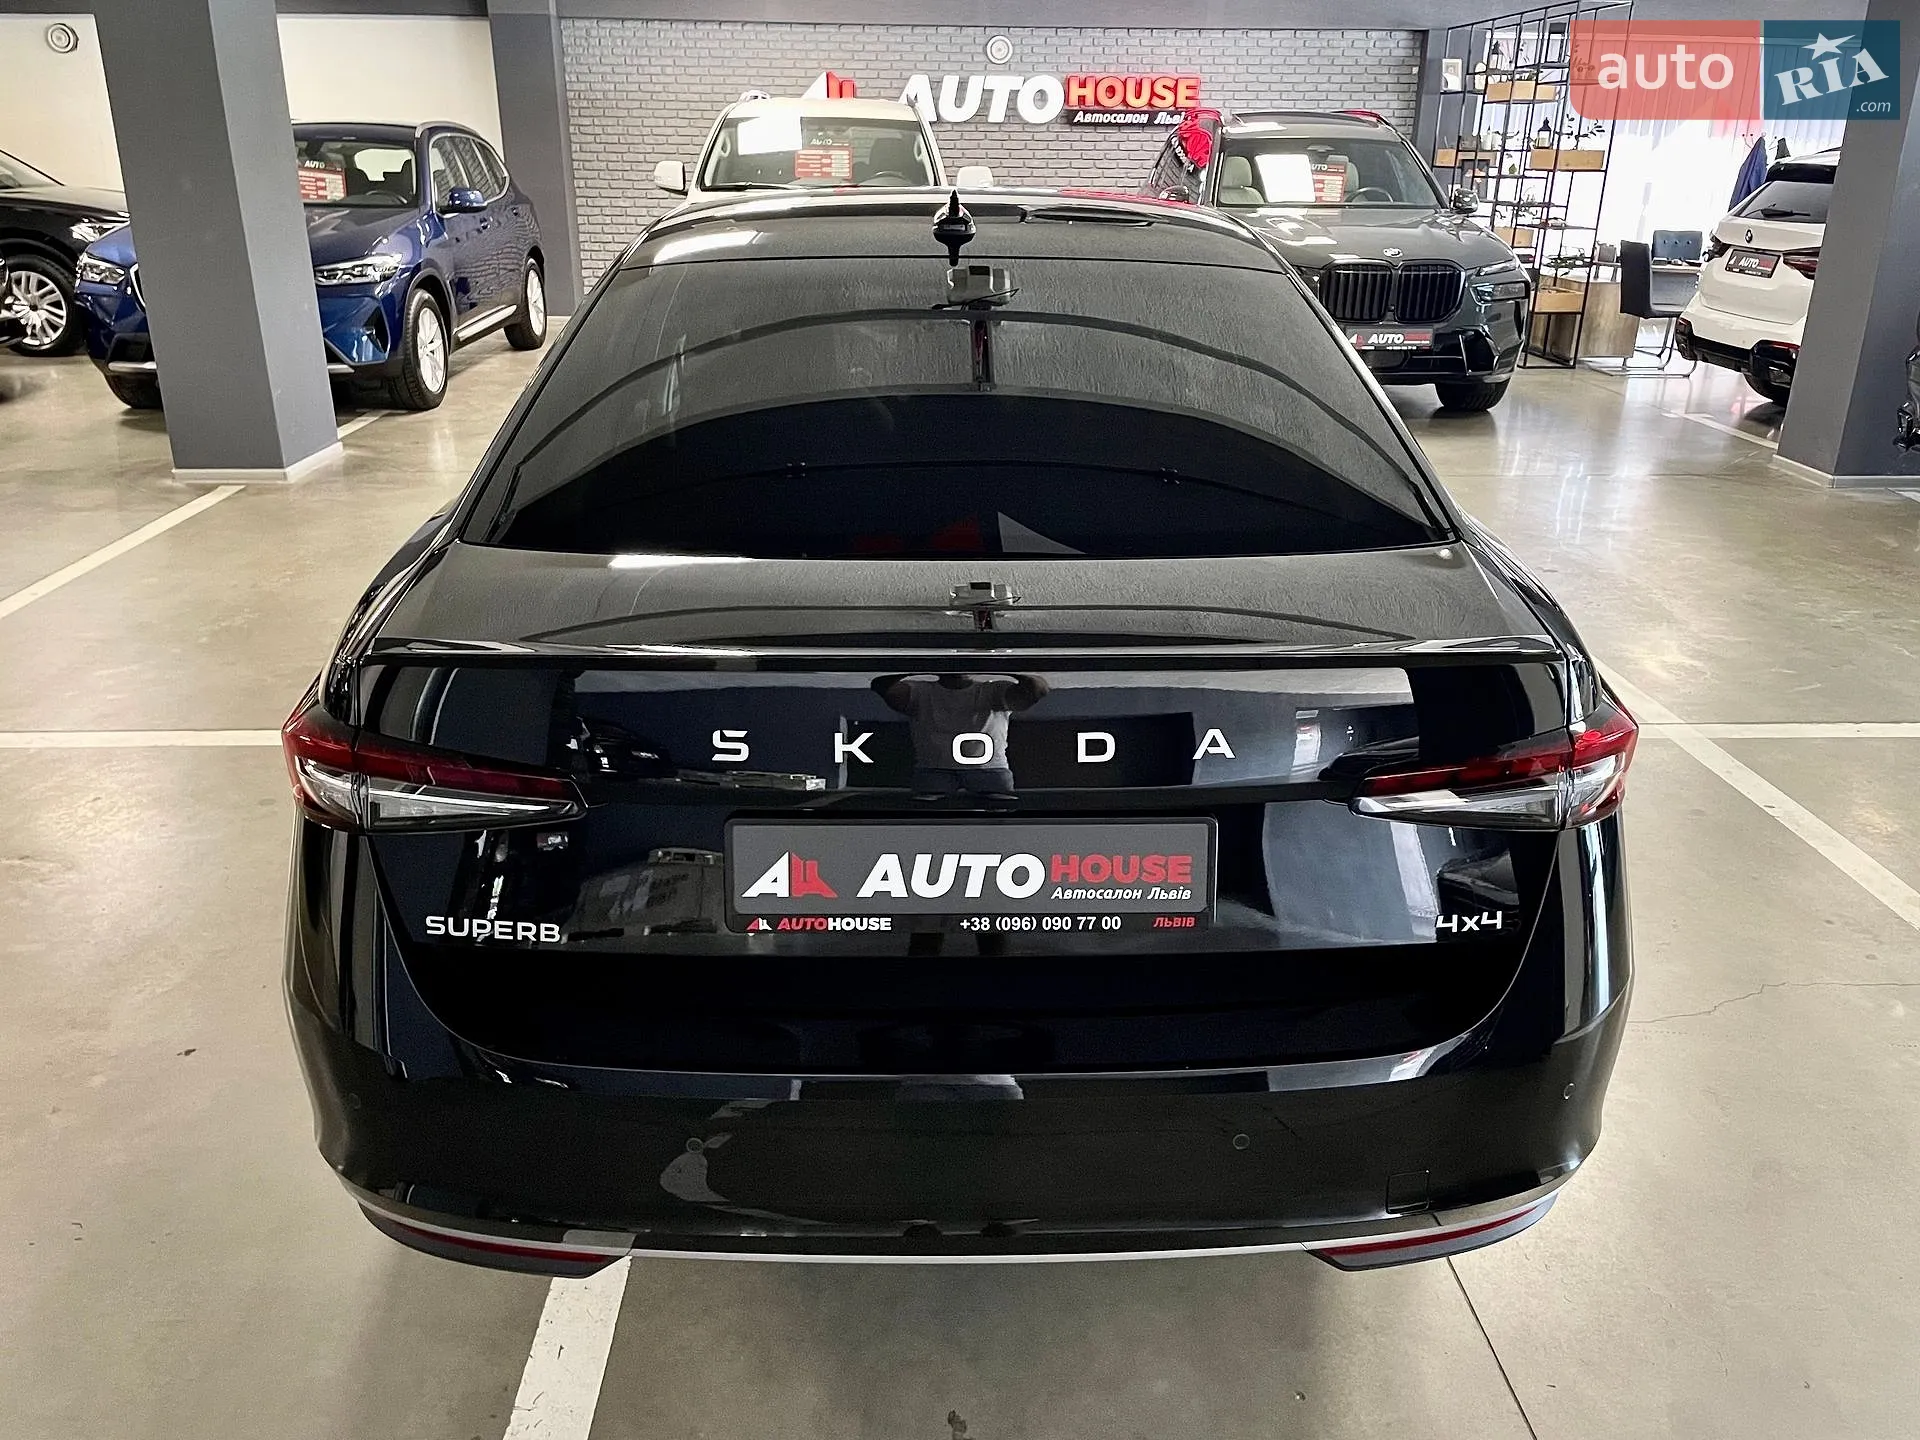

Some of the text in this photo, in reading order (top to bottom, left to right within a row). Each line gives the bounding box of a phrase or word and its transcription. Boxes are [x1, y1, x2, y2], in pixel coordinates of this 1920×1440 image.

[899, 74, 1201, 124] AUTO HOUSE
[1074, 111, 1149, 124] Автосалон
[304, 160, 325, 168] AUTO
[1311, 163, 1328, 171] UTO
[1738, 257, 1759, 268] AUTO
[1368, 333, 1405, 344] AUTO
[856, 853, 1193, 898] AUTO HOUSE
[1051, 886, 1192, 900] Автосалон Львів
[777, 916, 1196, 931] AUTOHOUSE +38 (096) 090 77 00 ЛЬВІВ
[1436, 911, 1502, 932] 4x4
[425, 915, 561, 943] SUPERB
